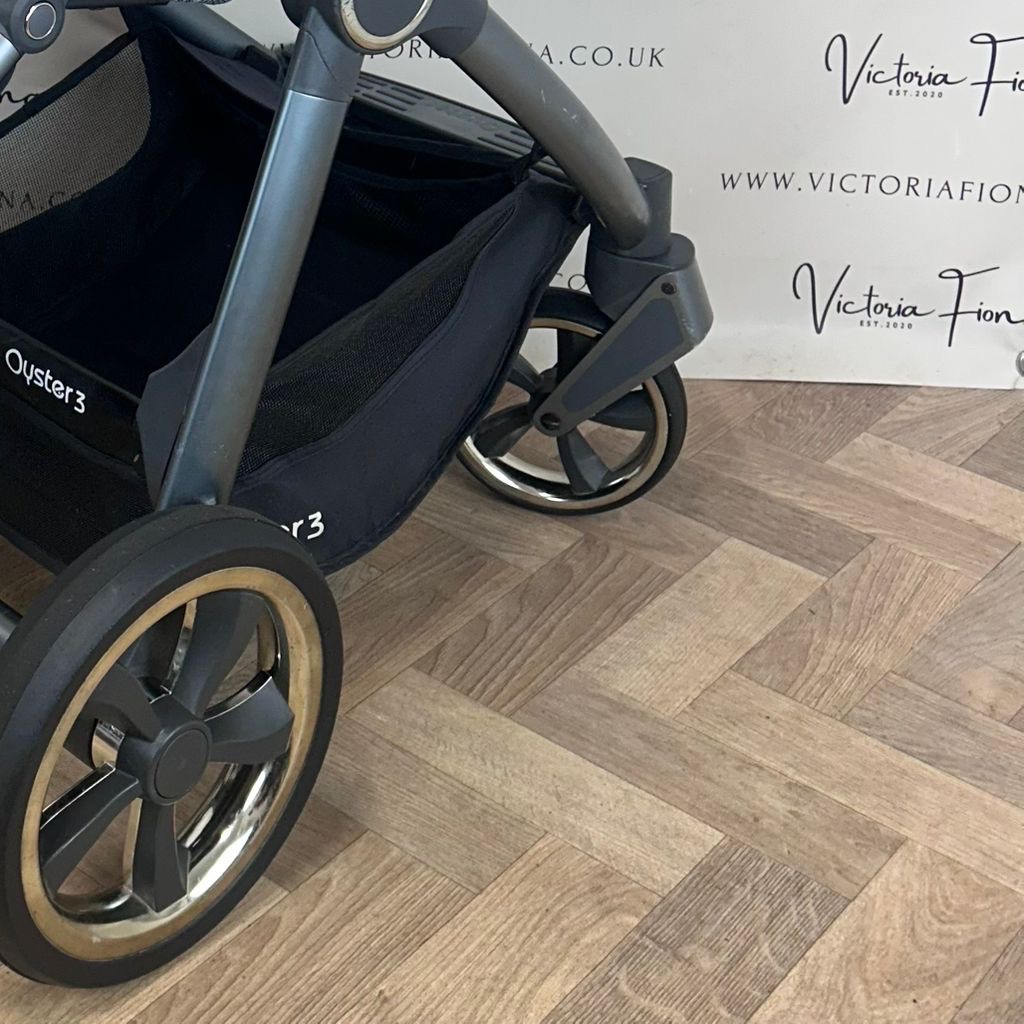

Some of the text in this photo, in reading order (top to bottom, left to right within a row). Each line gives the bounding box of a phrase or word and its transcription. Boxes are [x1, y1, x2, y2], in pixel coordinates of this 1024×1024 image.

[825, 33, 967, 105] Victoria
[888, 89, 943, 99] EST.2020
[792, 263, 1024, 347] Victoria Fion
[860, 320, 913, 330] EST.2020
